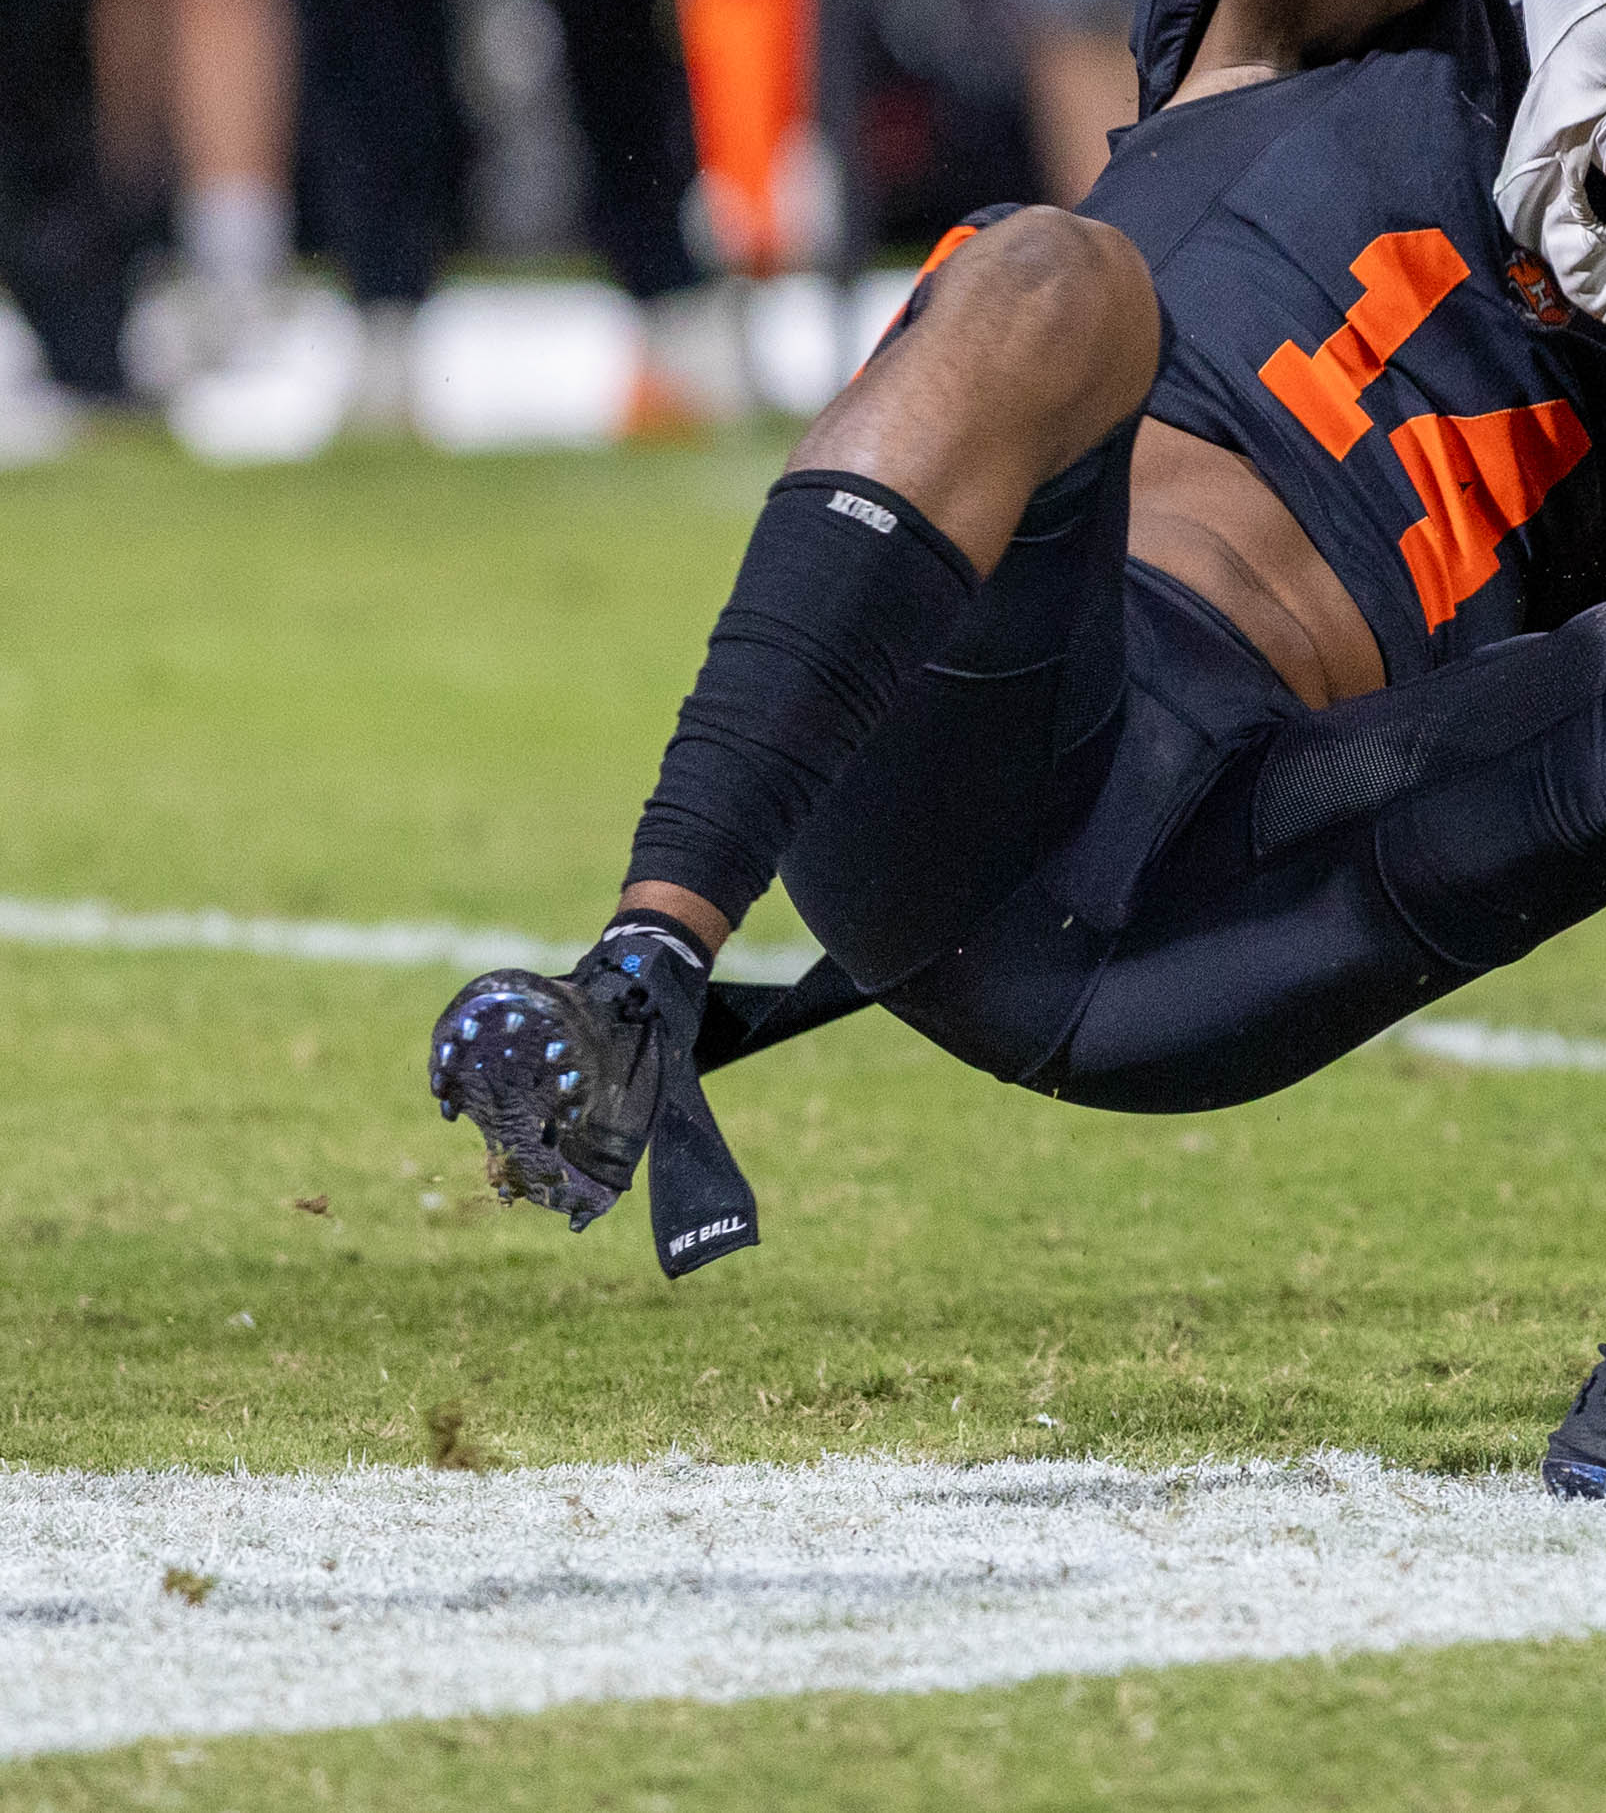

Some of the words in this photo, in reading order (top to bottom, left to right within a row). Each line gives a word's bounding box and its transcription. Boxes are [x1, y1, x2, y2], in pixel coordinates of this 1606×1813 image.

[1258, 227, 1593, 636] 14
[668, 1230, 697, 1258] WE
[698, 1215, 748, 1243] BALL
